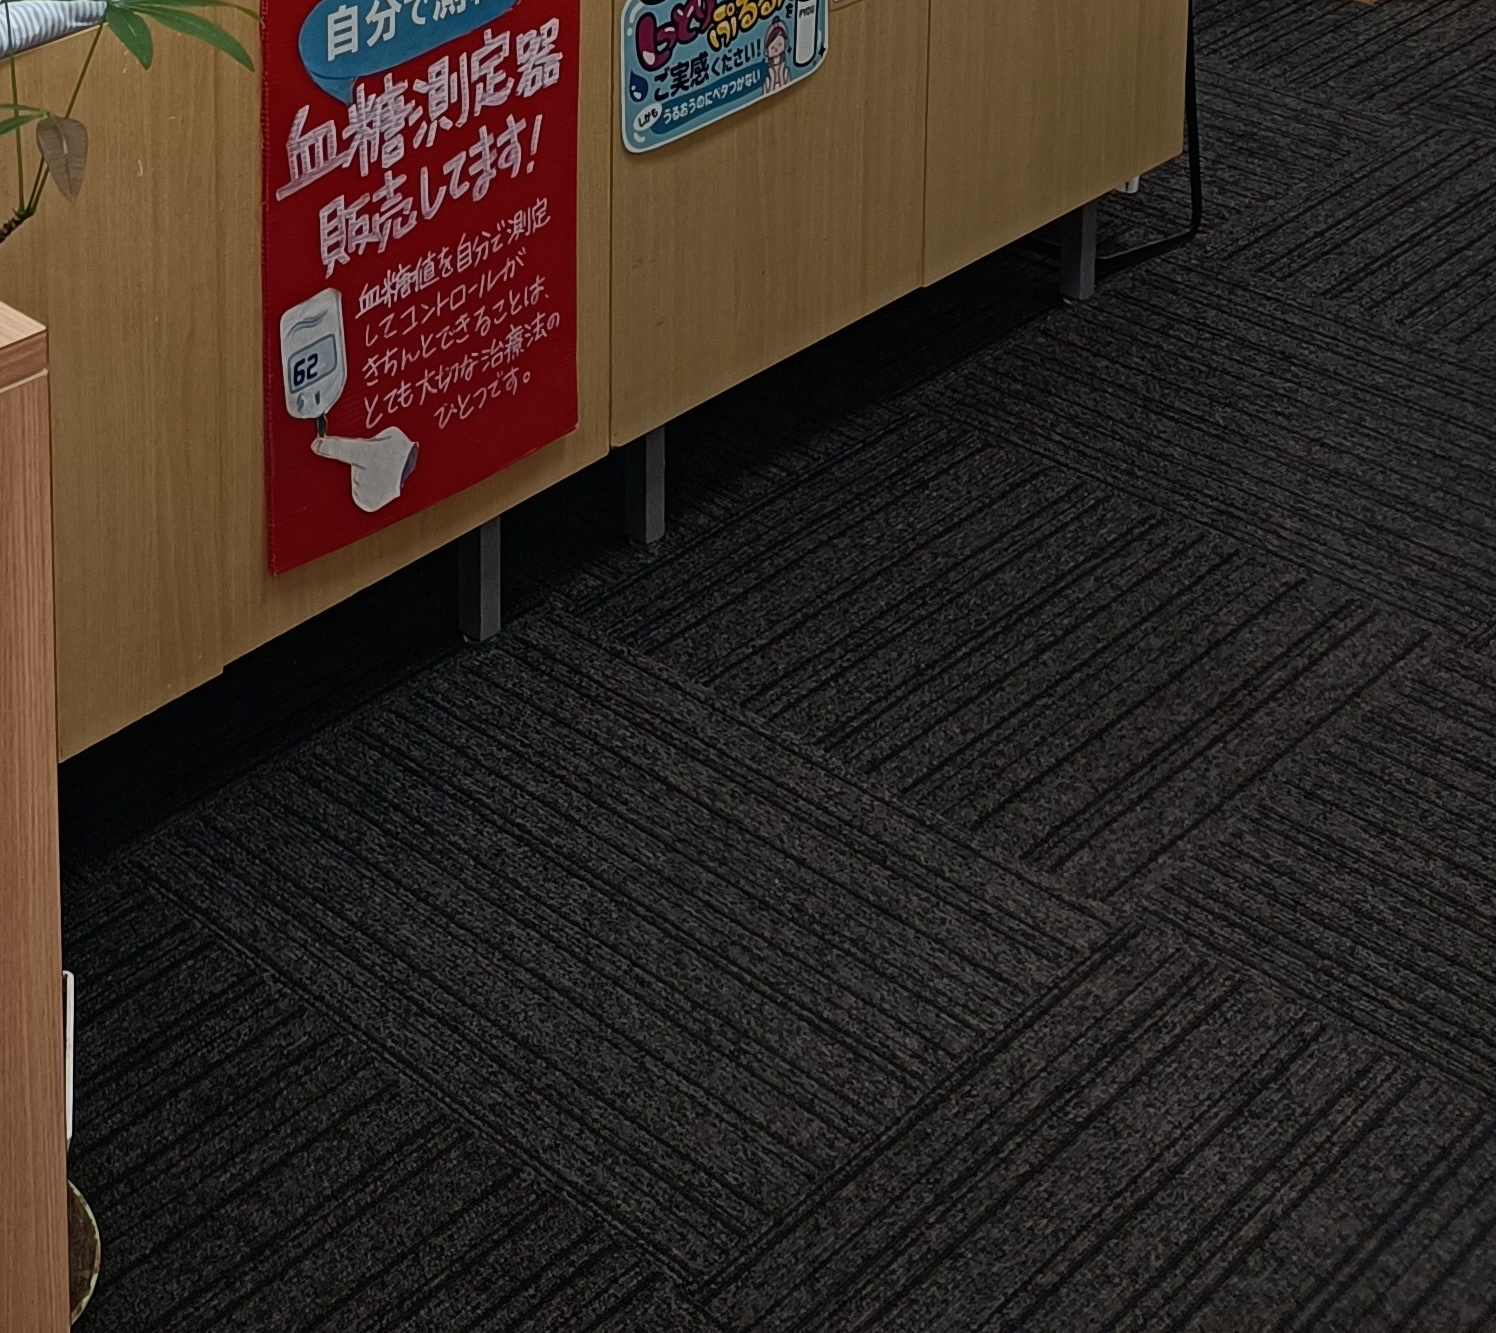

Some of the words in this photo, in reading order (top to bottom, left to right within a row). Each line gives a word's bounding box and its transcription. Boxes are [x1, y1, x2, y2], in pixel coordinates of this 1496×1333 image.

[275, 17, 566, 202] 血糖測定器
[637, 107, 659, 127] しかも
[653, 39, 763, 102] ご実感ください!
[662, 69, 762, 125] うるおうのにベタつかない
[317, 114, 547, 280] 販売してます!
[354, 196, 553, 321] 血糖値を自分で測定
[363, 247, 528, 348] してコントロールが
[292, 359, 320, 386] 62
[361, 275, 553, 387] きちんとできることは、
[361, 308, 562, 429] とても大切な治療法の
[432, 369, 535, 430] ひとつです。
